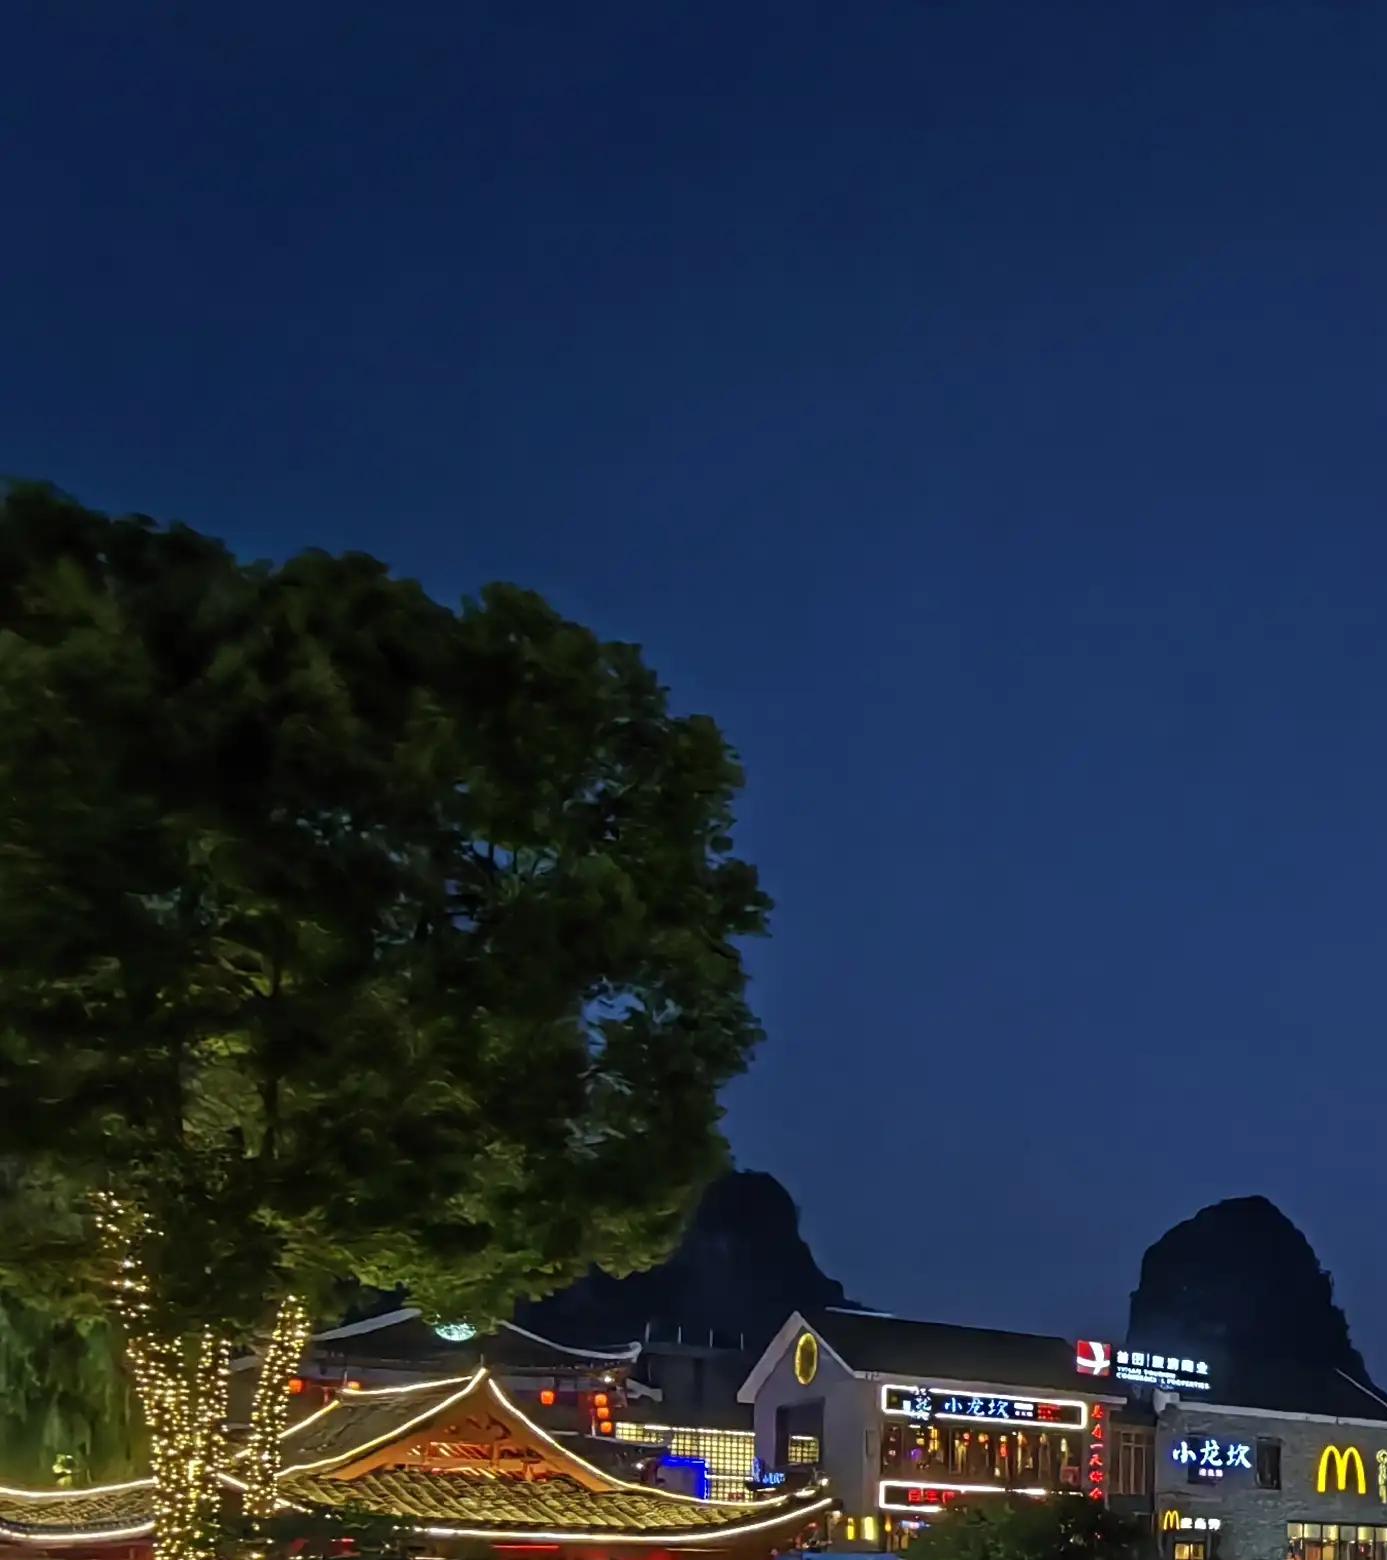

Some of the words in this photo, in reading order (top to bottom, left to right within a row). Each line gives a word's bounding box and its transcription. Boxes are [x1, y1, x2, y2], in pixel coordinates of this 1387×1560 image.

[944, 1397, 1010, 1419] 小龙坎
[1173, 1439, 1252, 1468] 小龙坎
